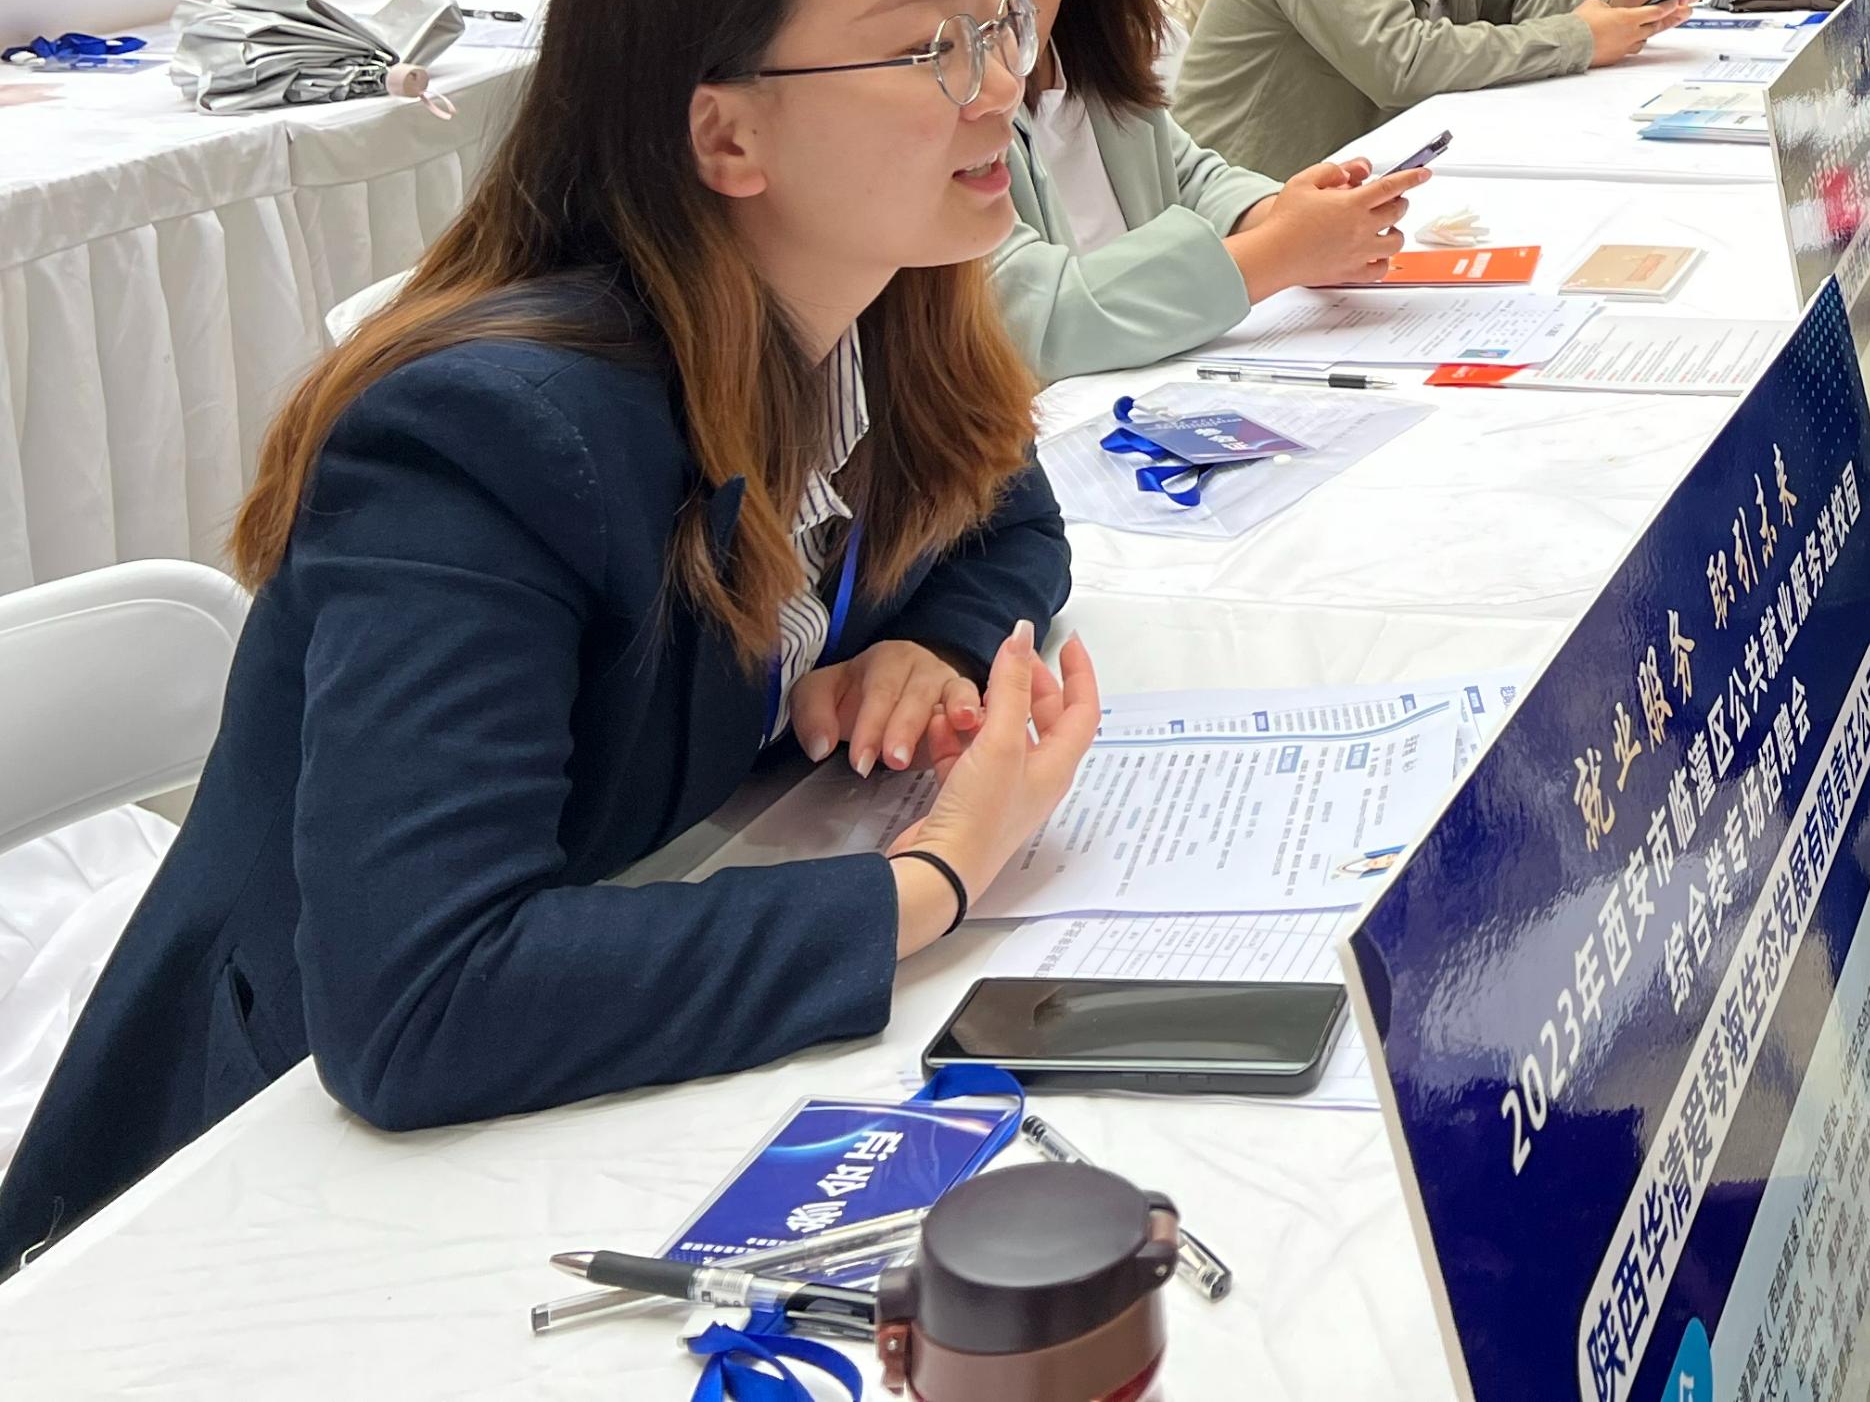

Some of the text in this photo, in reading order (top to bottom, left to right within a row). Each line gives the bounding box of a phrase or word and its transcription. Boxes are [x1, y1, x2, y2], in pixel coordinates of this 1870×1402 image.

[1501, 459, 1863, 1177] 2023年西安市临潼区公共就业服务进校园
[1571, 442, 1799, 853] 就业服务 职引未来
[1663, 674, 1812, 1012] 综合类专场招聘会
